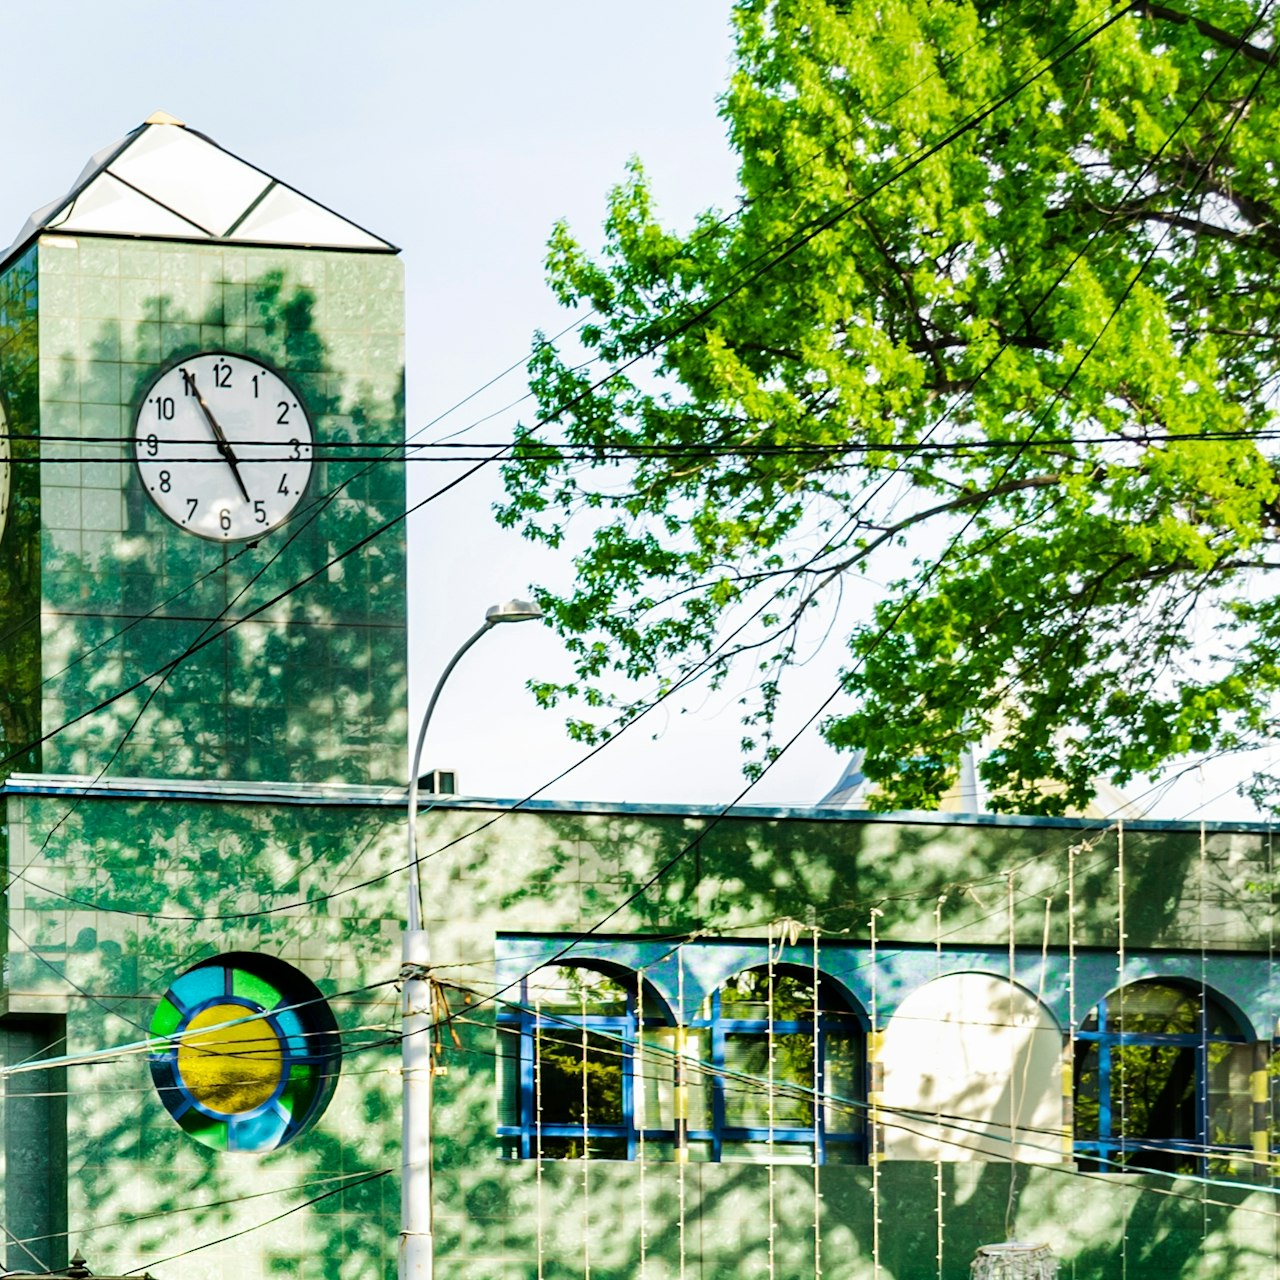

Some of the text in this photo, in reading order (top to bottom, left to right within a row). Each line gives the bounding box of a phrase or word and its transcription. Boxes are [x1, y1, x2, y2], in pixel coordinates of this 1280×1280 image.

[213, 364, 232, 388] 12
[251, 375, 259, 398] 1
[156, 397, 175, 420] 10
[277, 401, 290, 424] 2
[147, 434, 158, 456] 9
[289, 438, 301, 460] 3
[159, 470, 171, 493] 8
[277, 473, 289, 496] 4
[186, 499, 198, 521] 7
[219, 508, 231, 530] 6
[254, 501, 267, 523] 5
